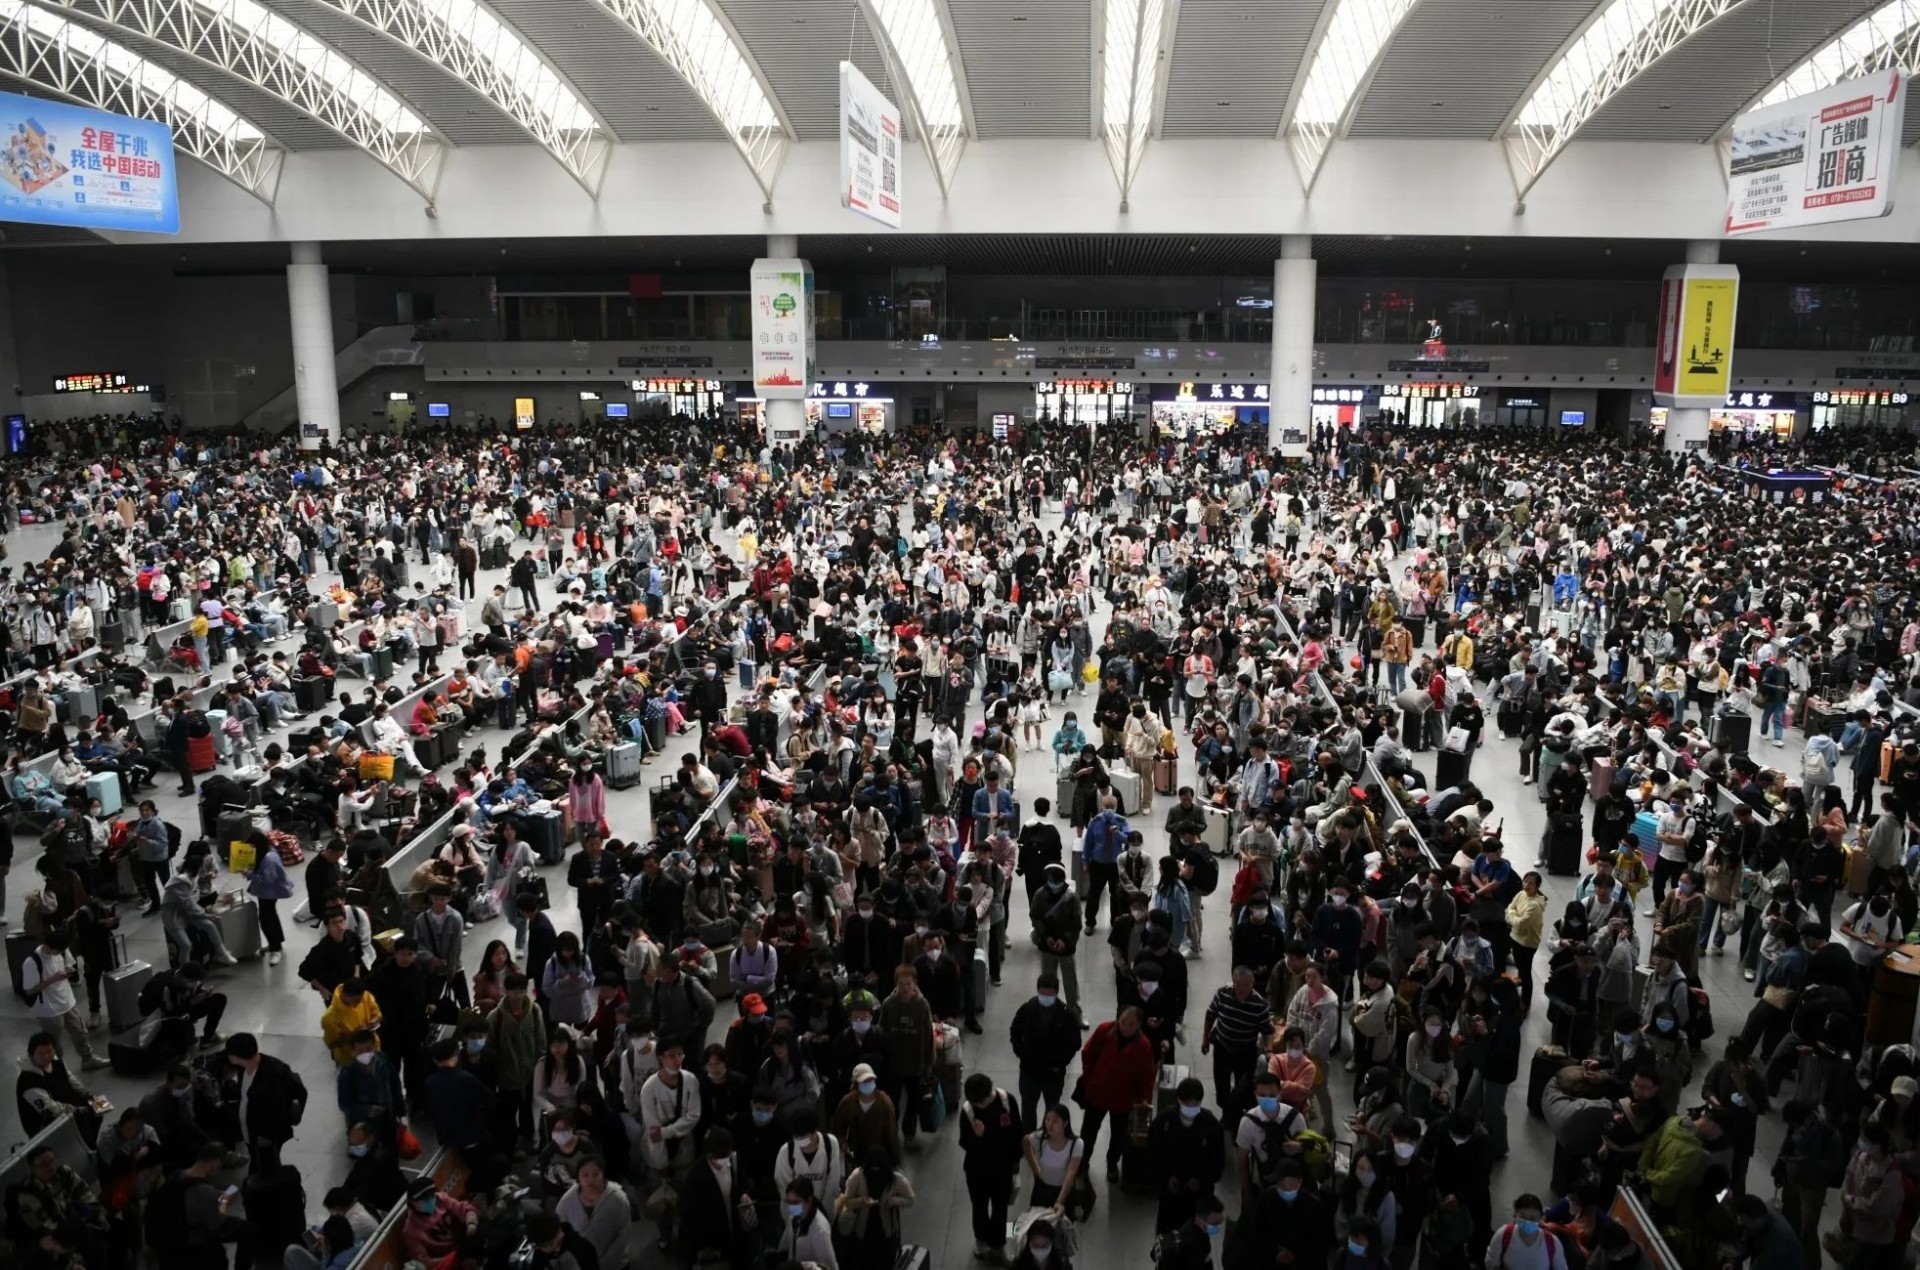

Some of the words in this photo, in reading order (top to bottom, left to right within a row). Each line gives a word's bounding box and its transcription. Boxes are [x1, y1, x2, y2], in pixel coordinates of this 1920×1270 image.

[1820, 116, 1869, 148] 广告媒体
[80, 126, 149, 157] 全屋千兆
[70, 148, 161, 179] 我选中国移动
[1817, 145, 1867, 189] 招商
[55, 379, 67, 390] B1
[115, 375, 126, 385] B1
[632, 380, 647, 391] B2
[706, 380, 721, 391] B3
[1039, 382, 1054, 393] B4
[1116, 382, 1131, 393] B5
[1384, 385, 1399, 395] B6
[1463, 386, 1479, 396] B7
[1813, 392, 1829, 402] B8
[1892, 393, 1908, 403] B9
